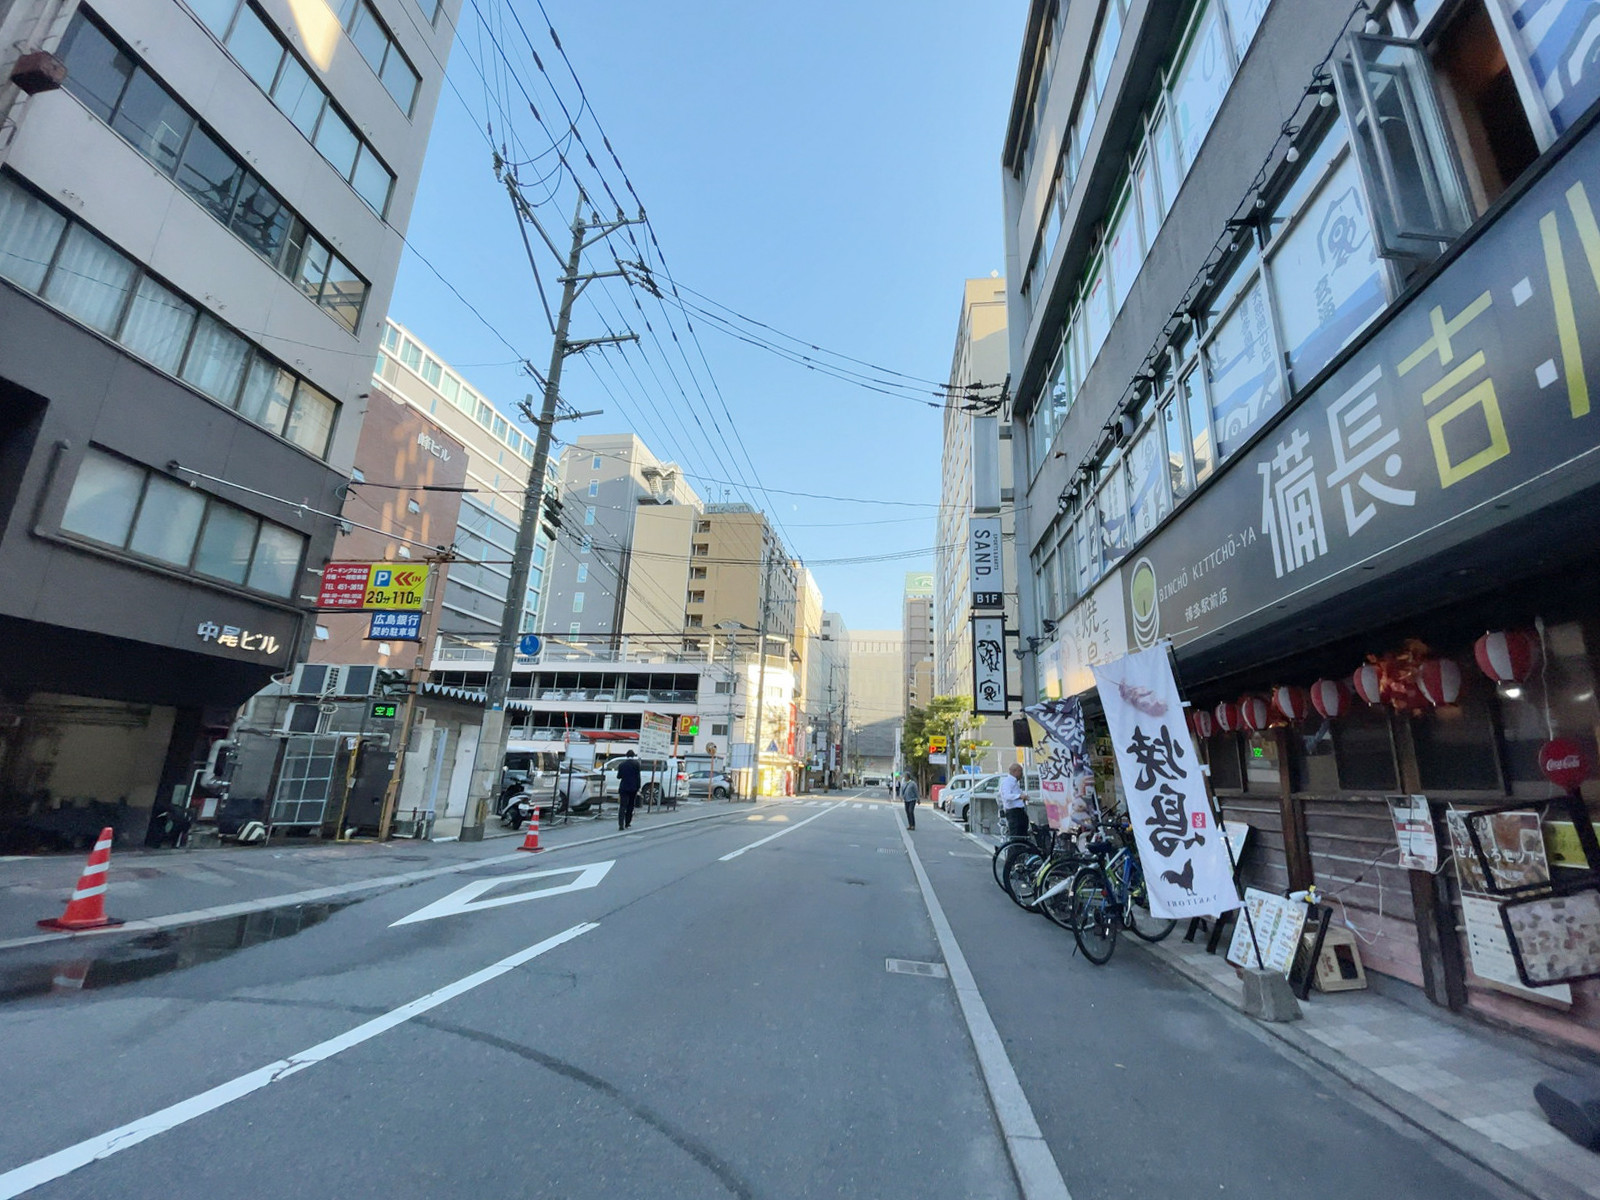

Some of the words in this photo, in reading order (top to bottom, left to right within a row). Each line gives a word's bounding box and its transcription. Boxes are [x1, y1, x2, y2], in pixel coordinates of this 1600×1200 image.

[974, 529, 992, 581] SAND.
[1192, 526, 1257, 581] KITTCHŌ-YA
[976, 593, 998, 604] B1F
[1184, 587, 1228, 623] 博多駅前店
[373, 614, 420, 626] 広島銀行
[196, 620, 280, 655] 中尾ビル
[371, 626, 417, 637] 契約駐車場
[374, 705, 395, 717] 空車
[681, 716, 691, 731] P
[1455, 844, 1540, 864] せんろセット
